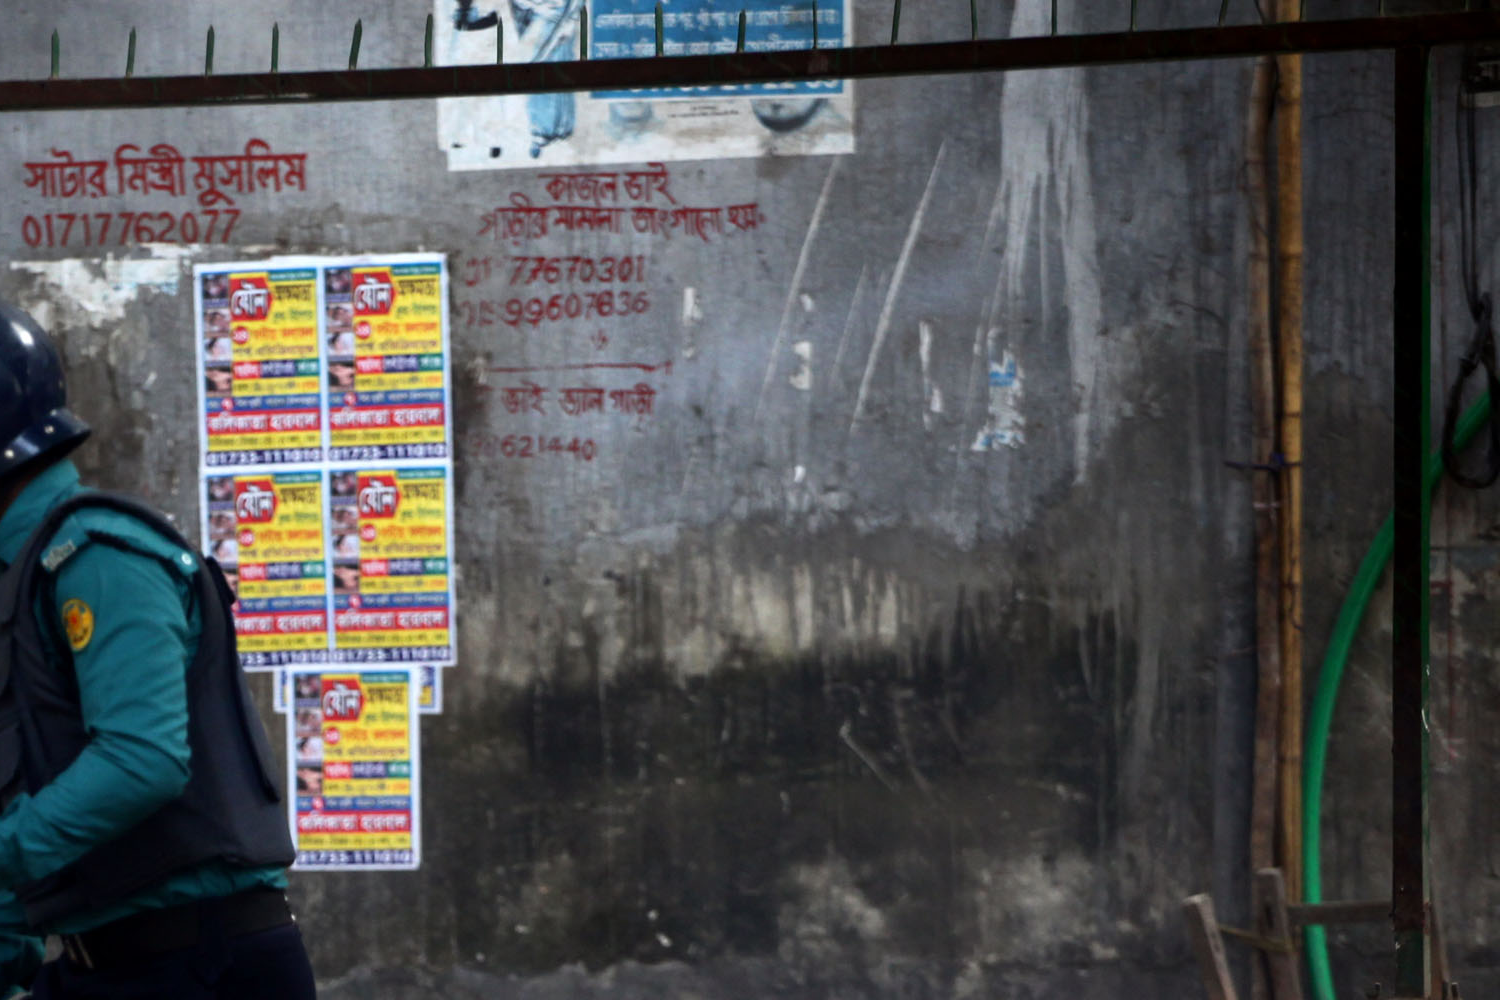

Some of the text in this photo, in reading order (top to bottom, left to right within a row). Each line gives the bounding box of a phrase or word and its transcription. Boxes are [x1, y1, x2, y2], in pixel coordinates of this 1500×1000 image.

[23, 147, 108, 198] সাটার
[191, 138, 308, 206] মুসলিম
[22, 208, 241, 247] 01717762077
[232, 280, 271, 317] যৌন
[355, 275, 391, 312] যৌন
[237, 485, 275, 519] যৌন
[360, 481, 397, 515] যৌন
[323, 682, 360, 717] যৌন
